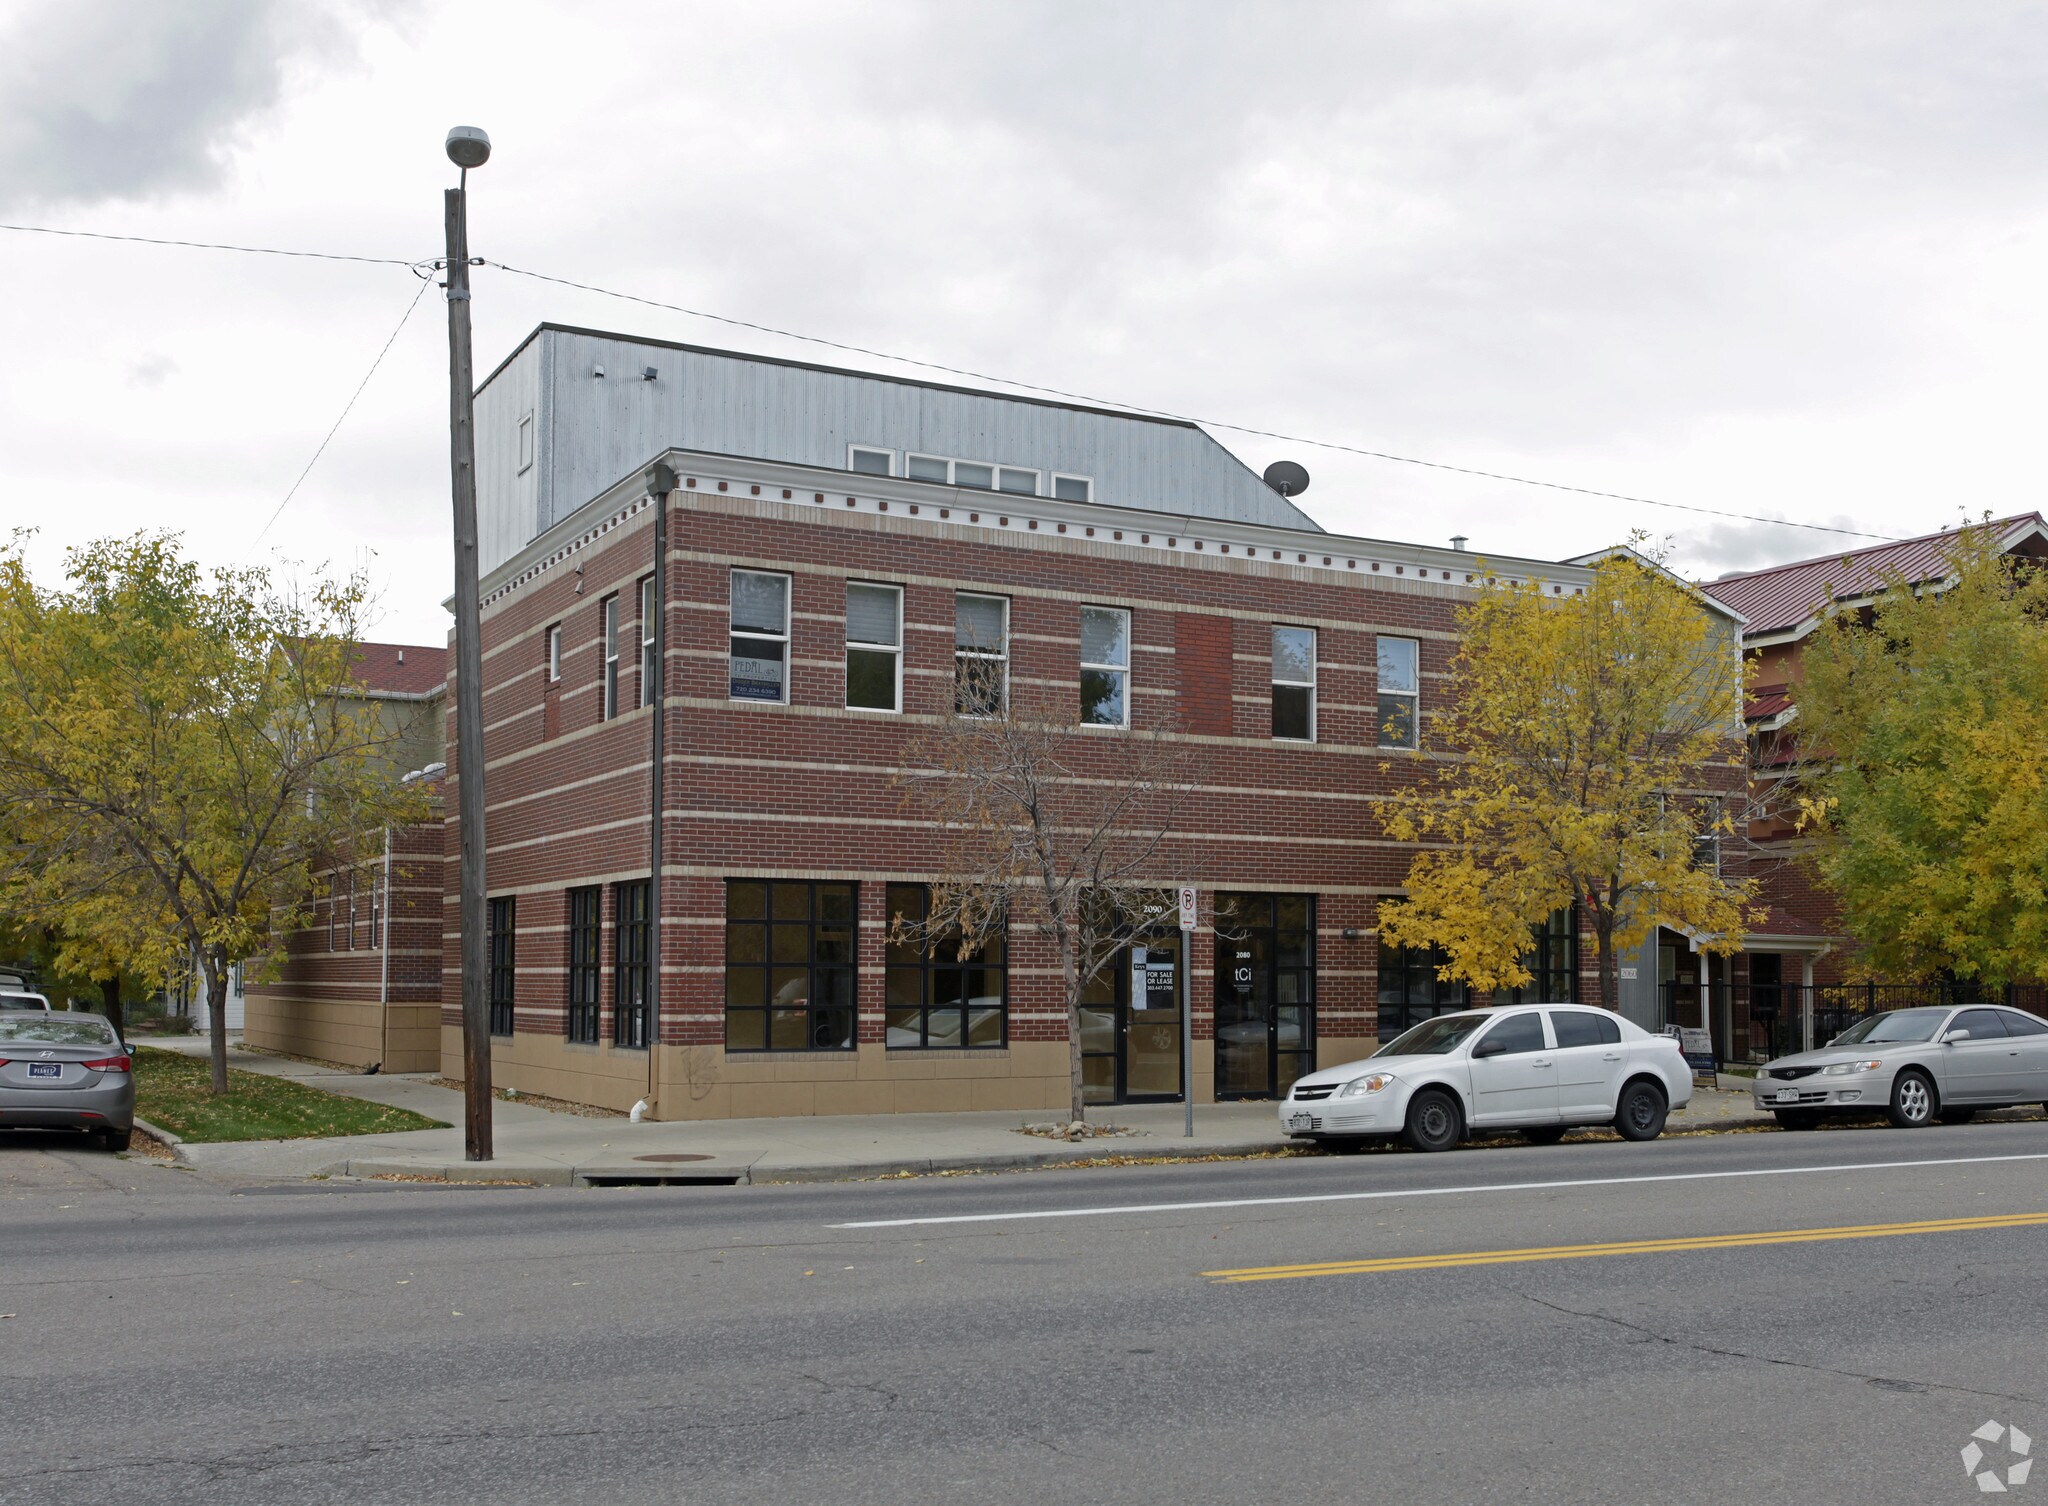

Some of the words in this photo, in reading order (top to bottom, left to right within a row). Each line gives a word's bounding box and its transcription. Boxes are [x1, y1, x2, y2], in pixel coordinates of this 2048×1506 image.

[734, 660, 763, 674] PEDAL
[1143, 905, 1163, 913] 2090
[1236, 951, 1251, 959] 2080
[1234, 967, 1252, 981] tCi
